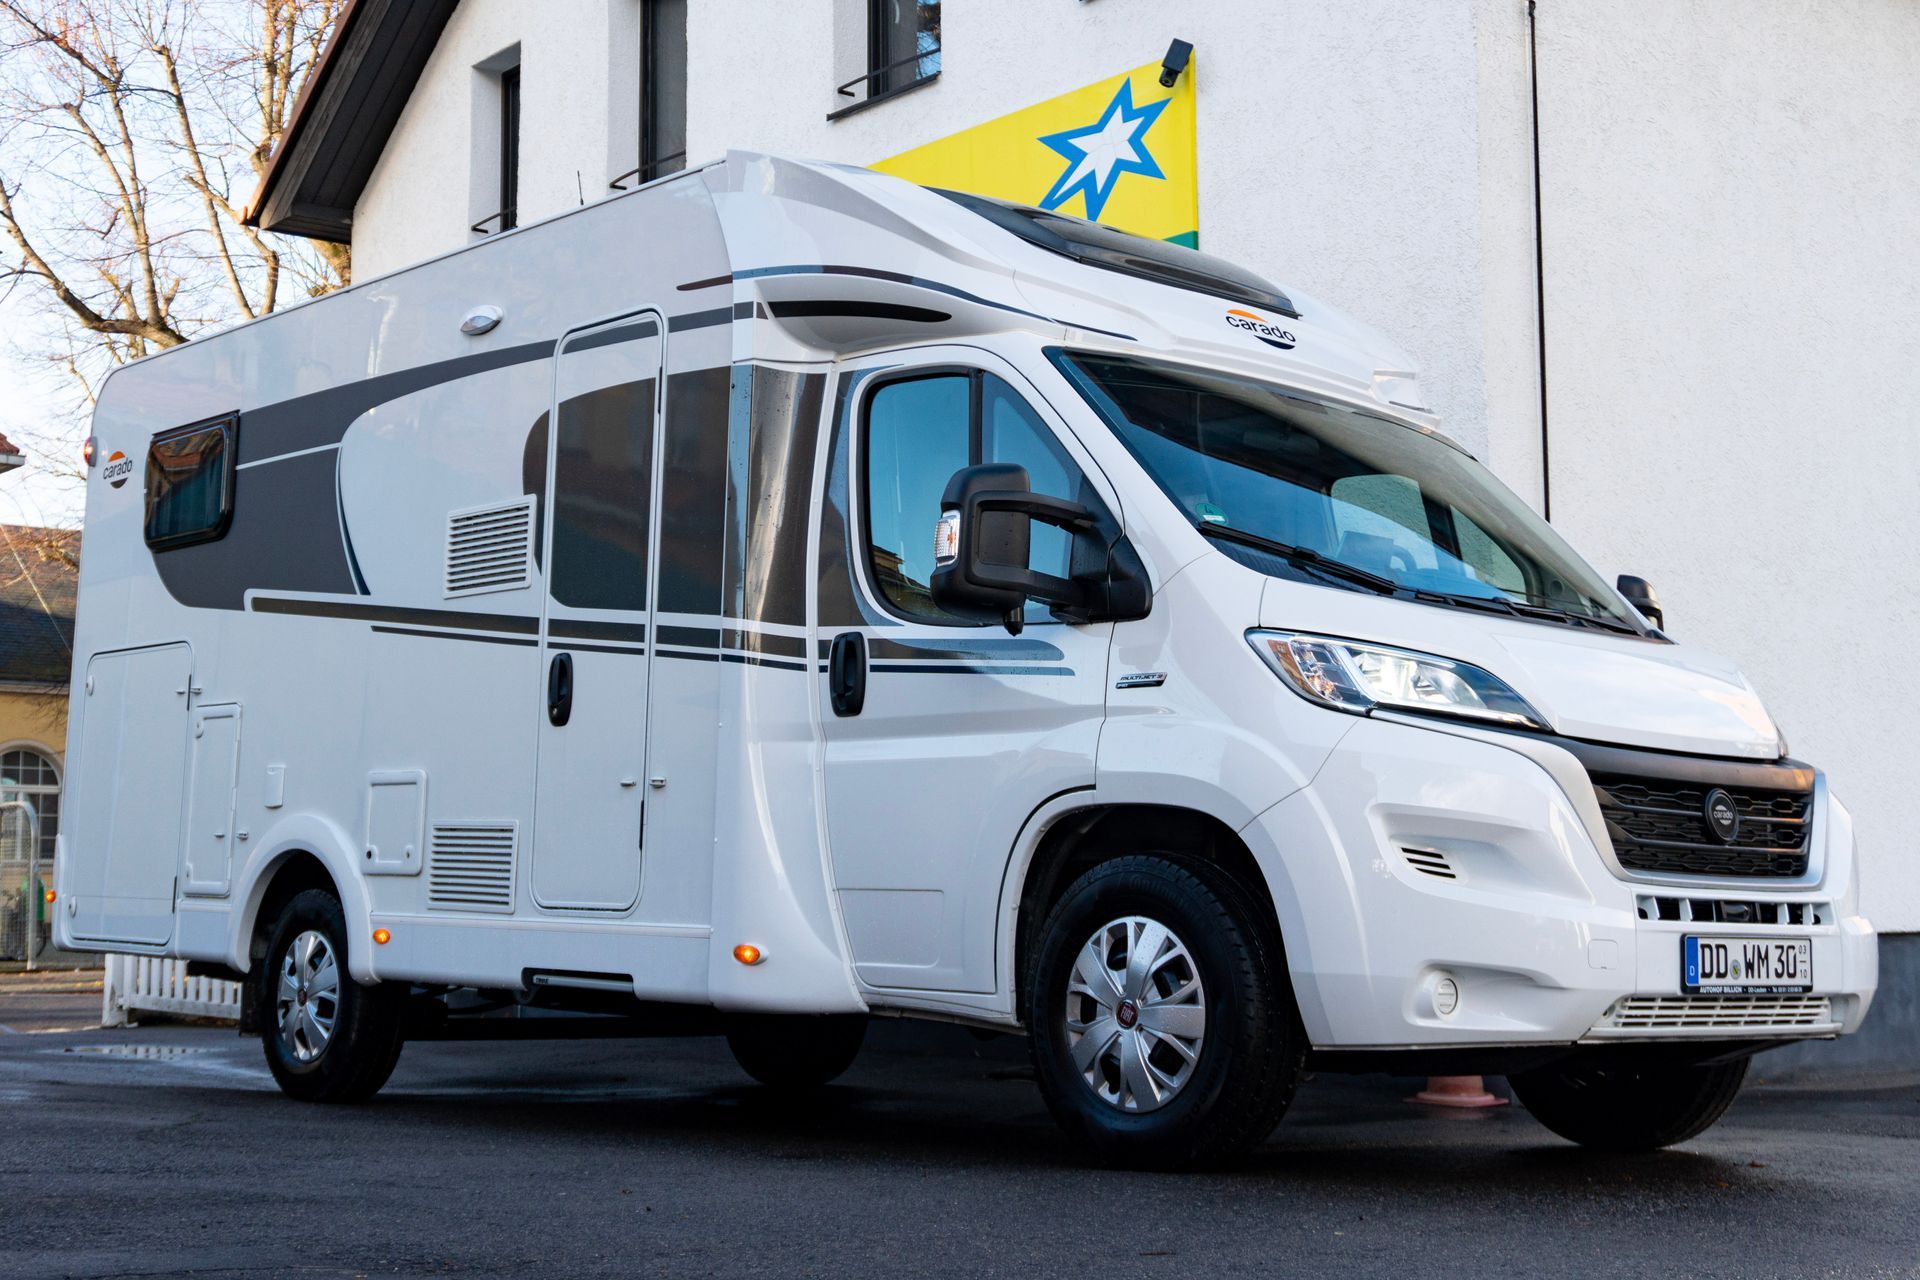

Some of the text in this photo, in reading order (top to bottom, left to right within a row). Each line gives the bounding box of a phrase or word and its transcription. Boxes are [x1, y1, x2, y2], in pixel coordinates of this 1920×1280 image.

[1225, 316, 1296, 342] carado
[103, 457, 133, 480] carado
[1713, 810, 1734, 819] carado
[1799, 945, 1807, 955] 03
[1700, 943, 1797, 980] DD WM 30
[1689, 965, 1695, 977] D
